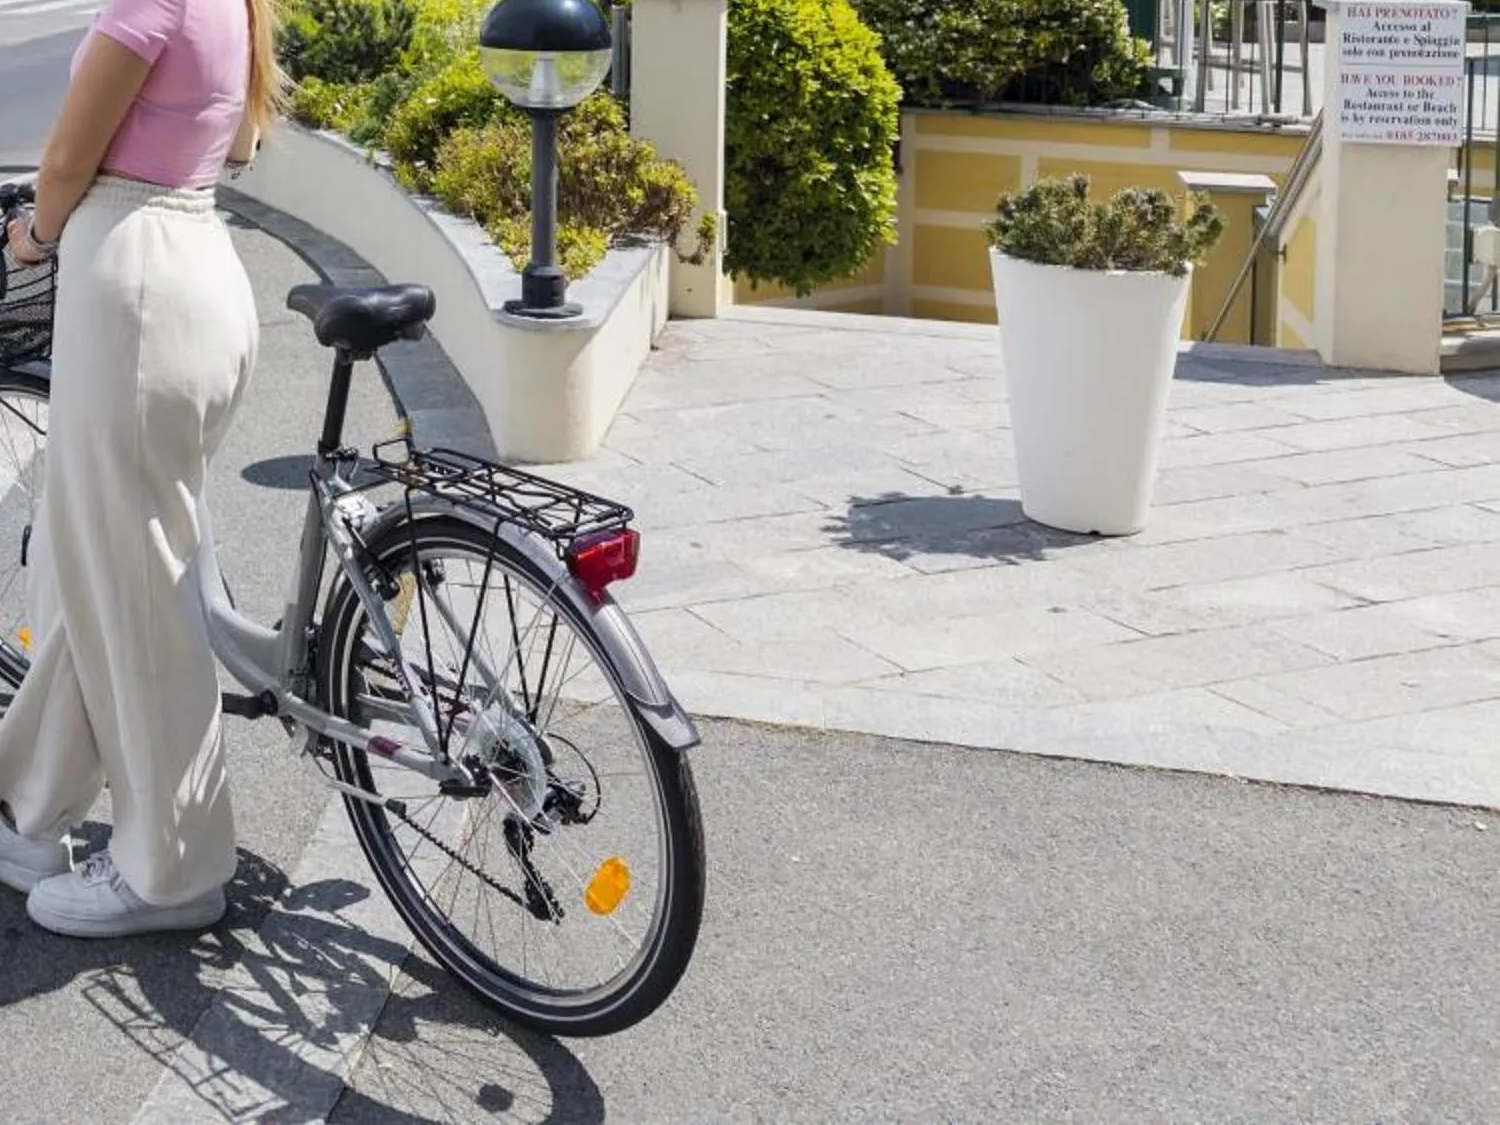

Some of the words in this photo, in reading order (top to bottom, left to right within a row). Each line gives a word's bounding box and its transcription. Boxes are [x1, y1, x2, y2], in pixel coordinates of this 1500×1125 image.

[1347, 6, 1371, 18] HAI
[1374, 20, 1417, 31] Accesso
[1420, 21, 1431, 31] al
[1343, 32, 1399, 44] Ristorante
[1414, 34, 1460, 47] Spiaggia
[1342, 46, 1363, 56] solo
[1366, 48, 1385, 56] con
[1389, 46, 1458, 59] prenotazione
[1341, 74, 1371, 85] HAVE
[1375, 74, 1400, 86] YOU
[1366, 88, 1400, 98] Access
[1403, 89, 1415, 99] to
[1417, 88, 1435, 99] the
[1343, 99, 1403, 112] Restaurant
[1407, 104, 1420, 112] or
[1423, 101, 1457, 113] Beach
[1340, 114, 1349, 122] is
[1353, 113, 1365, 126] by
[1369, 115, 1431, 125] reservation
[1434, 115, 1457, 127] only
